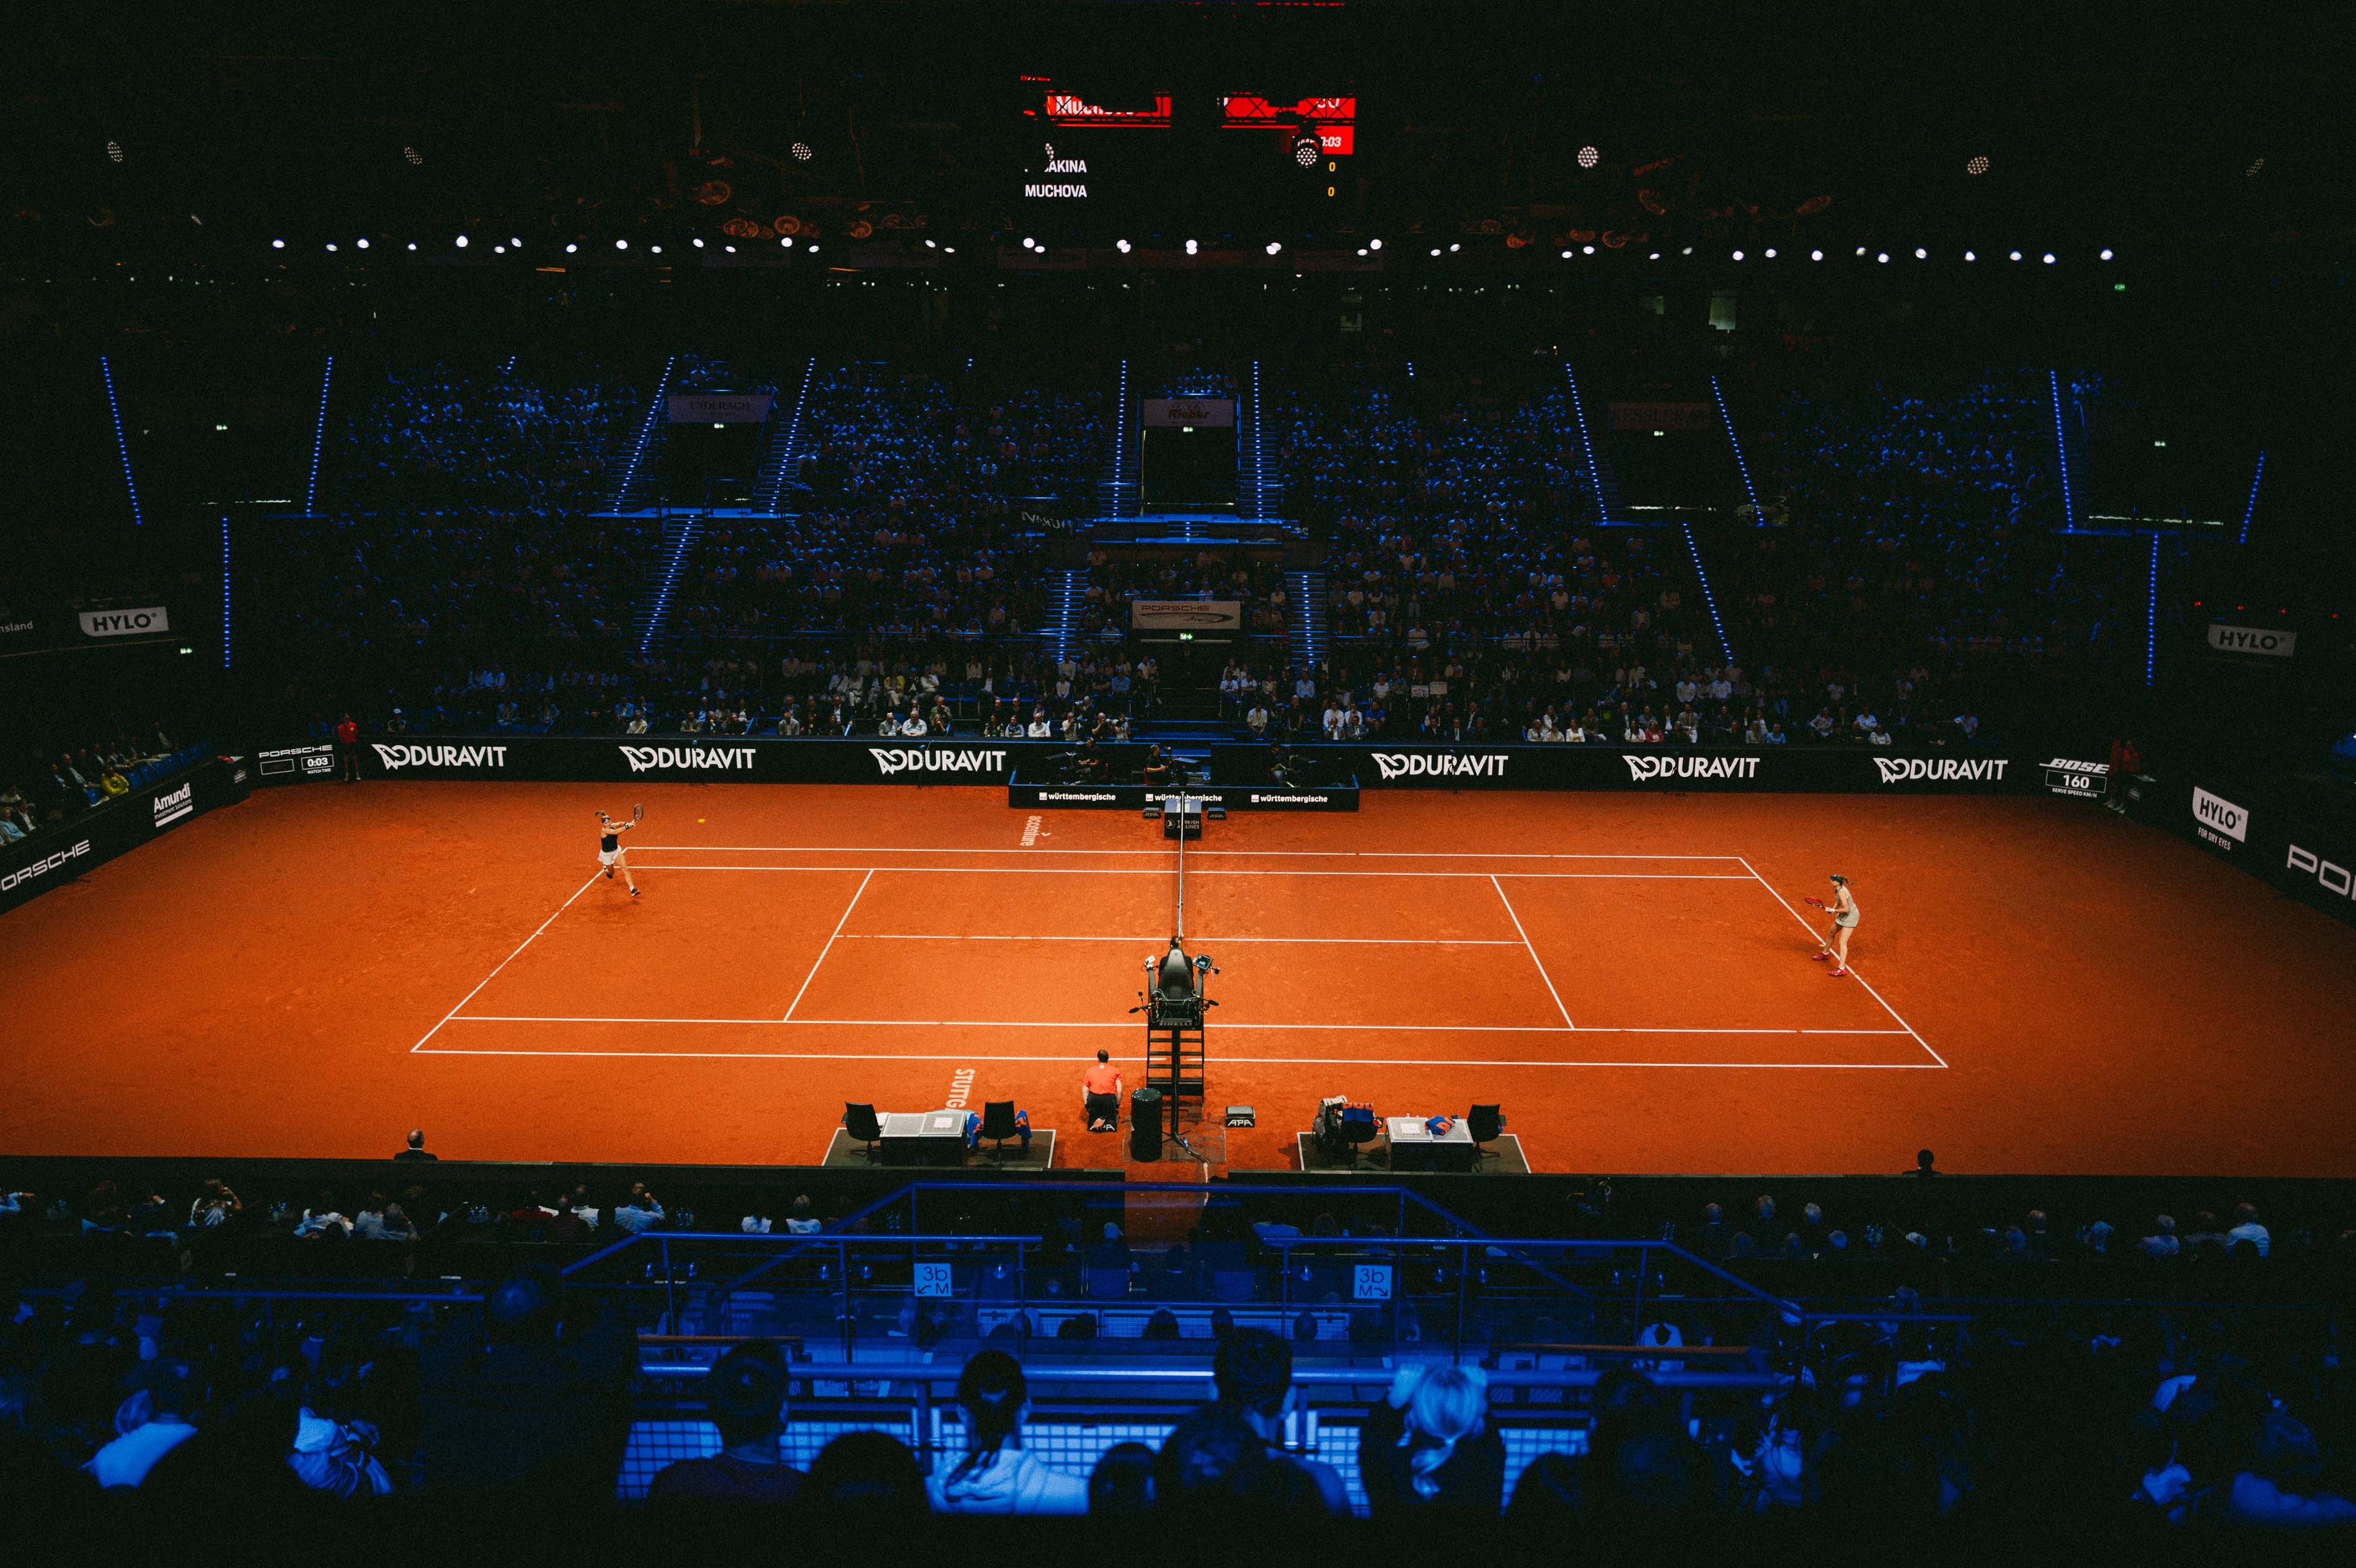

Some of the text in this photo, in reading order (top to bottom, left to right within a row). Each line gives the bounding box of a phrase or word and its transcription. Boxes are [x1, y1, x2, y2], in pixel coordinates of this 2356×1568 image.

[1329, 162, 1335, 172] 0
[1025, 185, 1087, 197] MUCHOVA
[1327, 187, 1335, 197] 0
[259, 745, 333, 758] PORSCHE
[410, 745, 507, 767] DURAVIT
[658, 747, 756, 769] DURAVIT
[307, 757, 328, 767] 0:03
[908, 750, 1006, 771] DURAVIT
[1409, 754, 1508, 776] DURAVIT
[1660, 756, 1760, 778] DURAVIT
[2039, 758, 2110, 774] BOSE
[1910, 758, 2008, 780] DURAVIT
[2063, 774, 2090, 789] 160
[153, 782, 191, 814] Amundi
[1048, 792, 1116, 801] württembergische
[1154, 794, 1223, 802] württebergische
[1260, 795, 1328, 804] württembergische
[2198, 827, 2231, 851] FOR DRY EYES
[0, 839, 91, 891] ORSCHE
[945, 1068, 975, 1110] STUTTG
[923, 1266, 947, 1282] 3b
[1360, 1268, 1384, 1284] 3b
[936, 1282, 949, 1295] M
[1359, 1285, 1373, 1296] M
